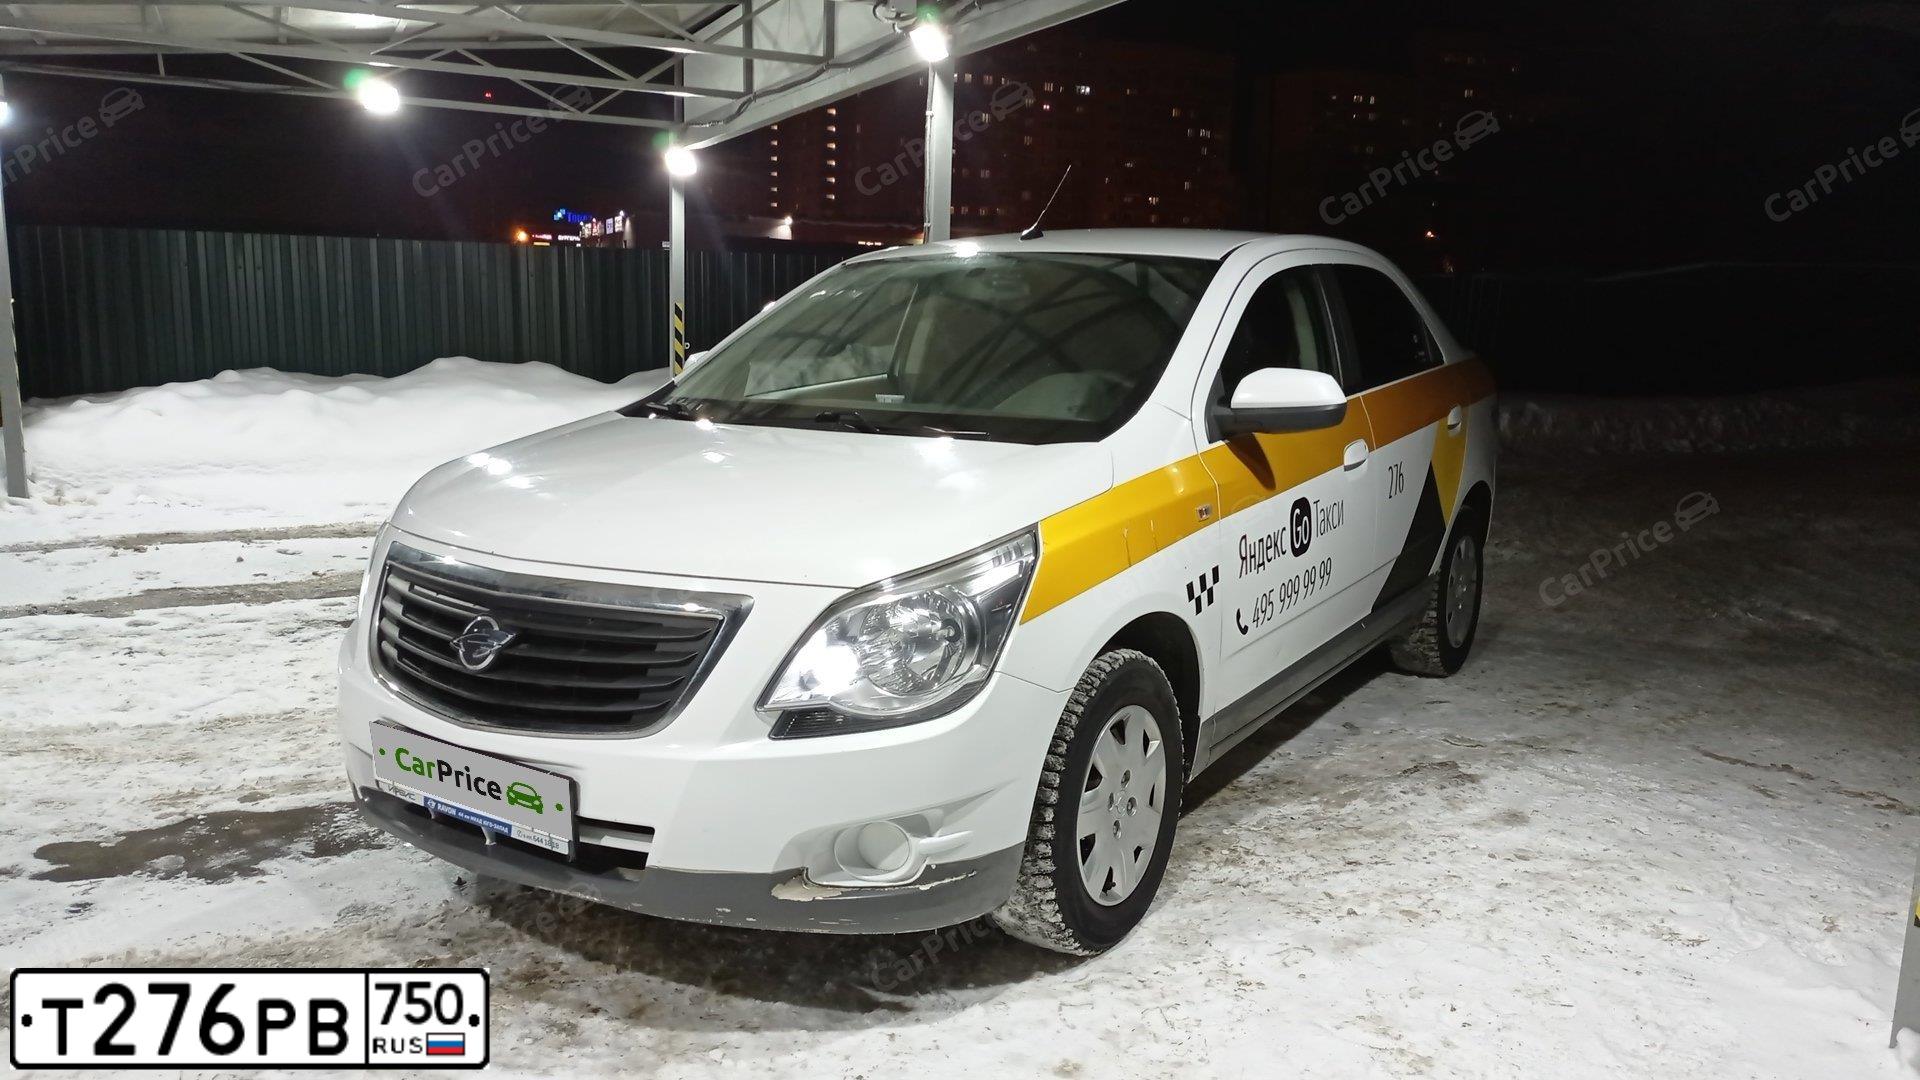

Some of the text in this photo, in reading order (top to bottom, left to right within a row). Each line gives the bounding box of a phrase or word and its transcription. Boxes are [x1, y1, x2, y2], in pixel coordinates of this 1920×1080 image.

[1388, 461, 1404, 499] 276
[1238, 499, 1344, 579] Яндекс Go Такси
[1252, 557, 1332, 628] 495 999 99 99
